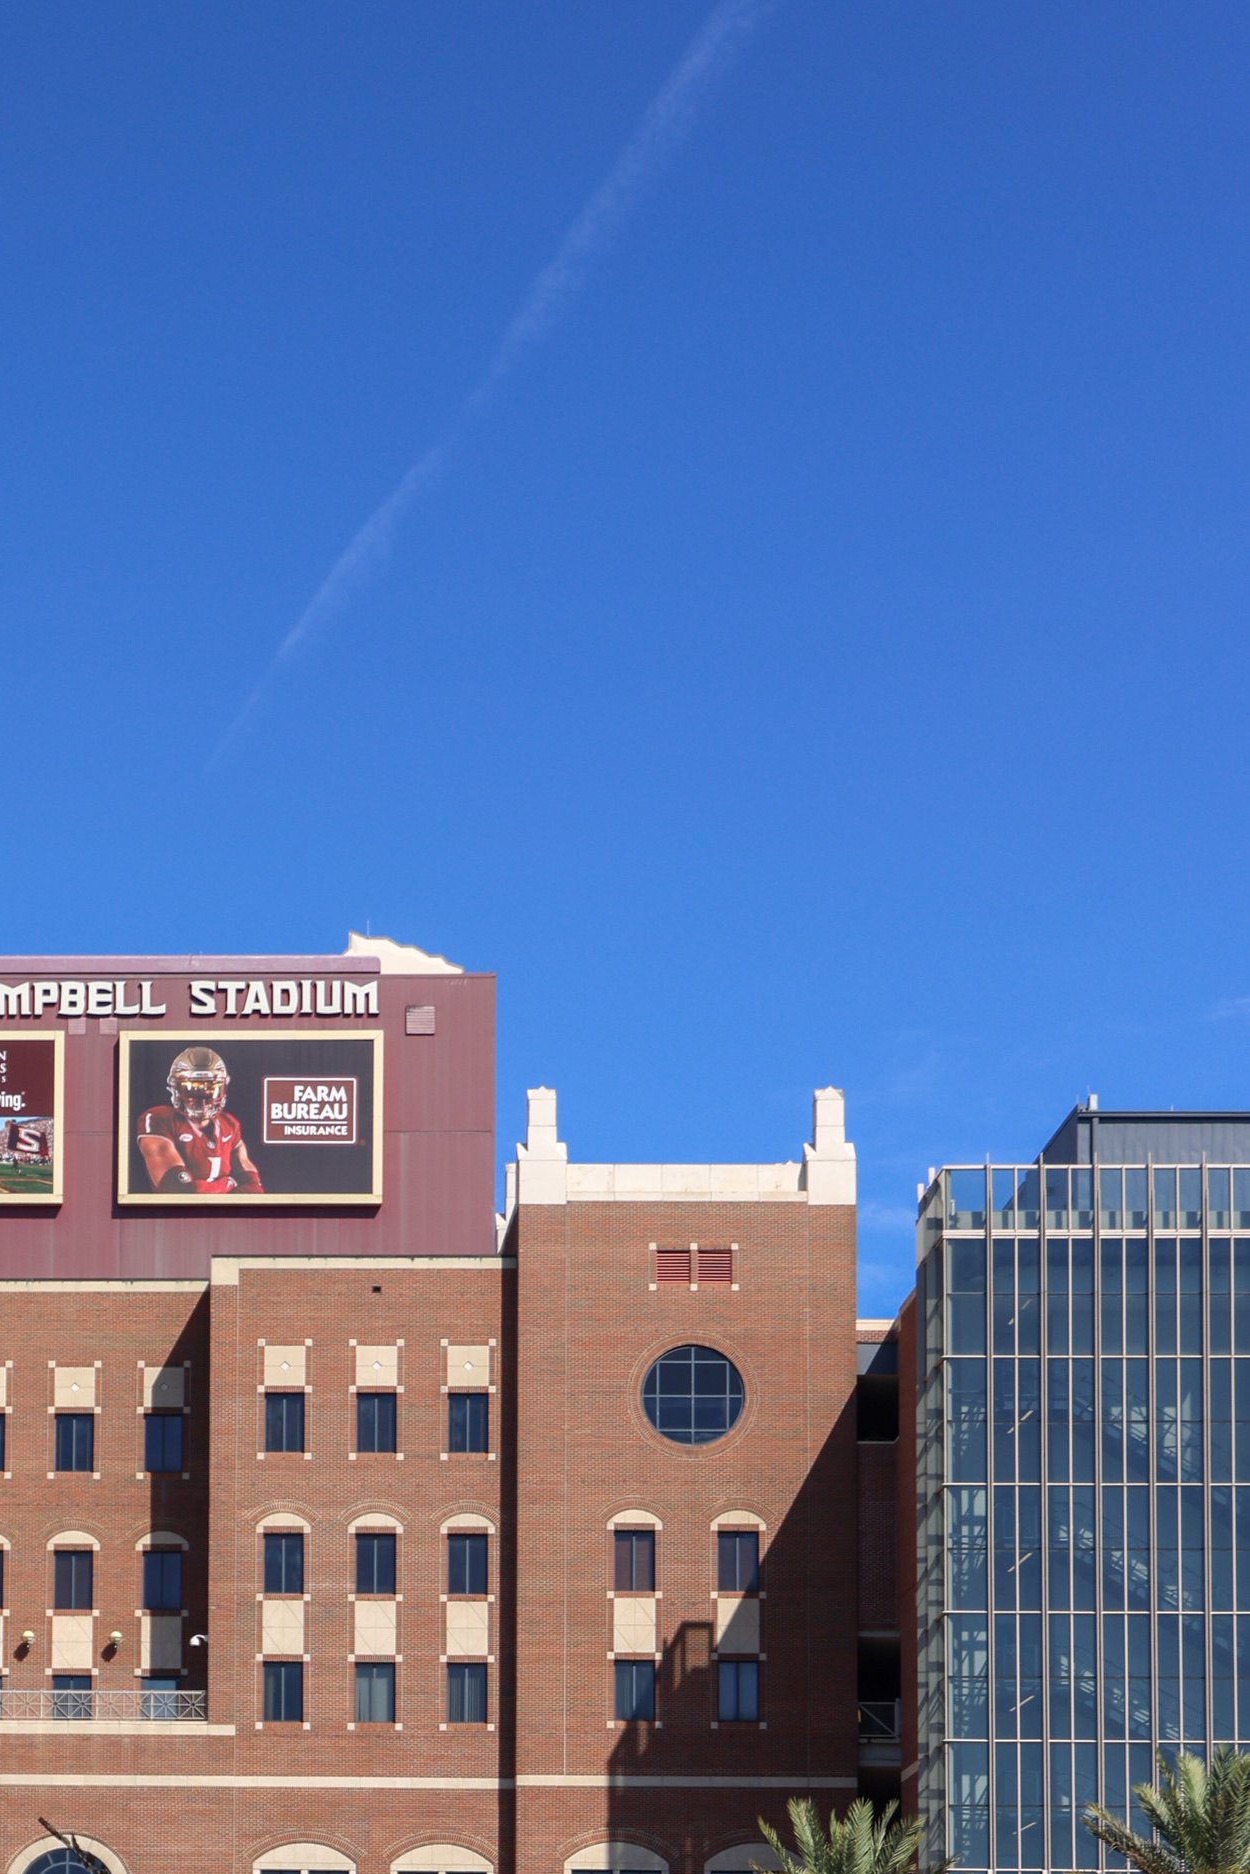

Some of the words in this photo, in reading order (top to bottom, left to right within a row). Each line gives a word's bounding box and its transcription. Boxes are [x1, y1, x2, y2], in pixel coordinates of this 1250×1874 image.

[189, 980, 379, 1017] STADIUM
[294, 1085, 348, 1102] FARM
[271, 1103, 348, 1120] BUREAU
[284, 1125, 348, 1136] INSURANCE
